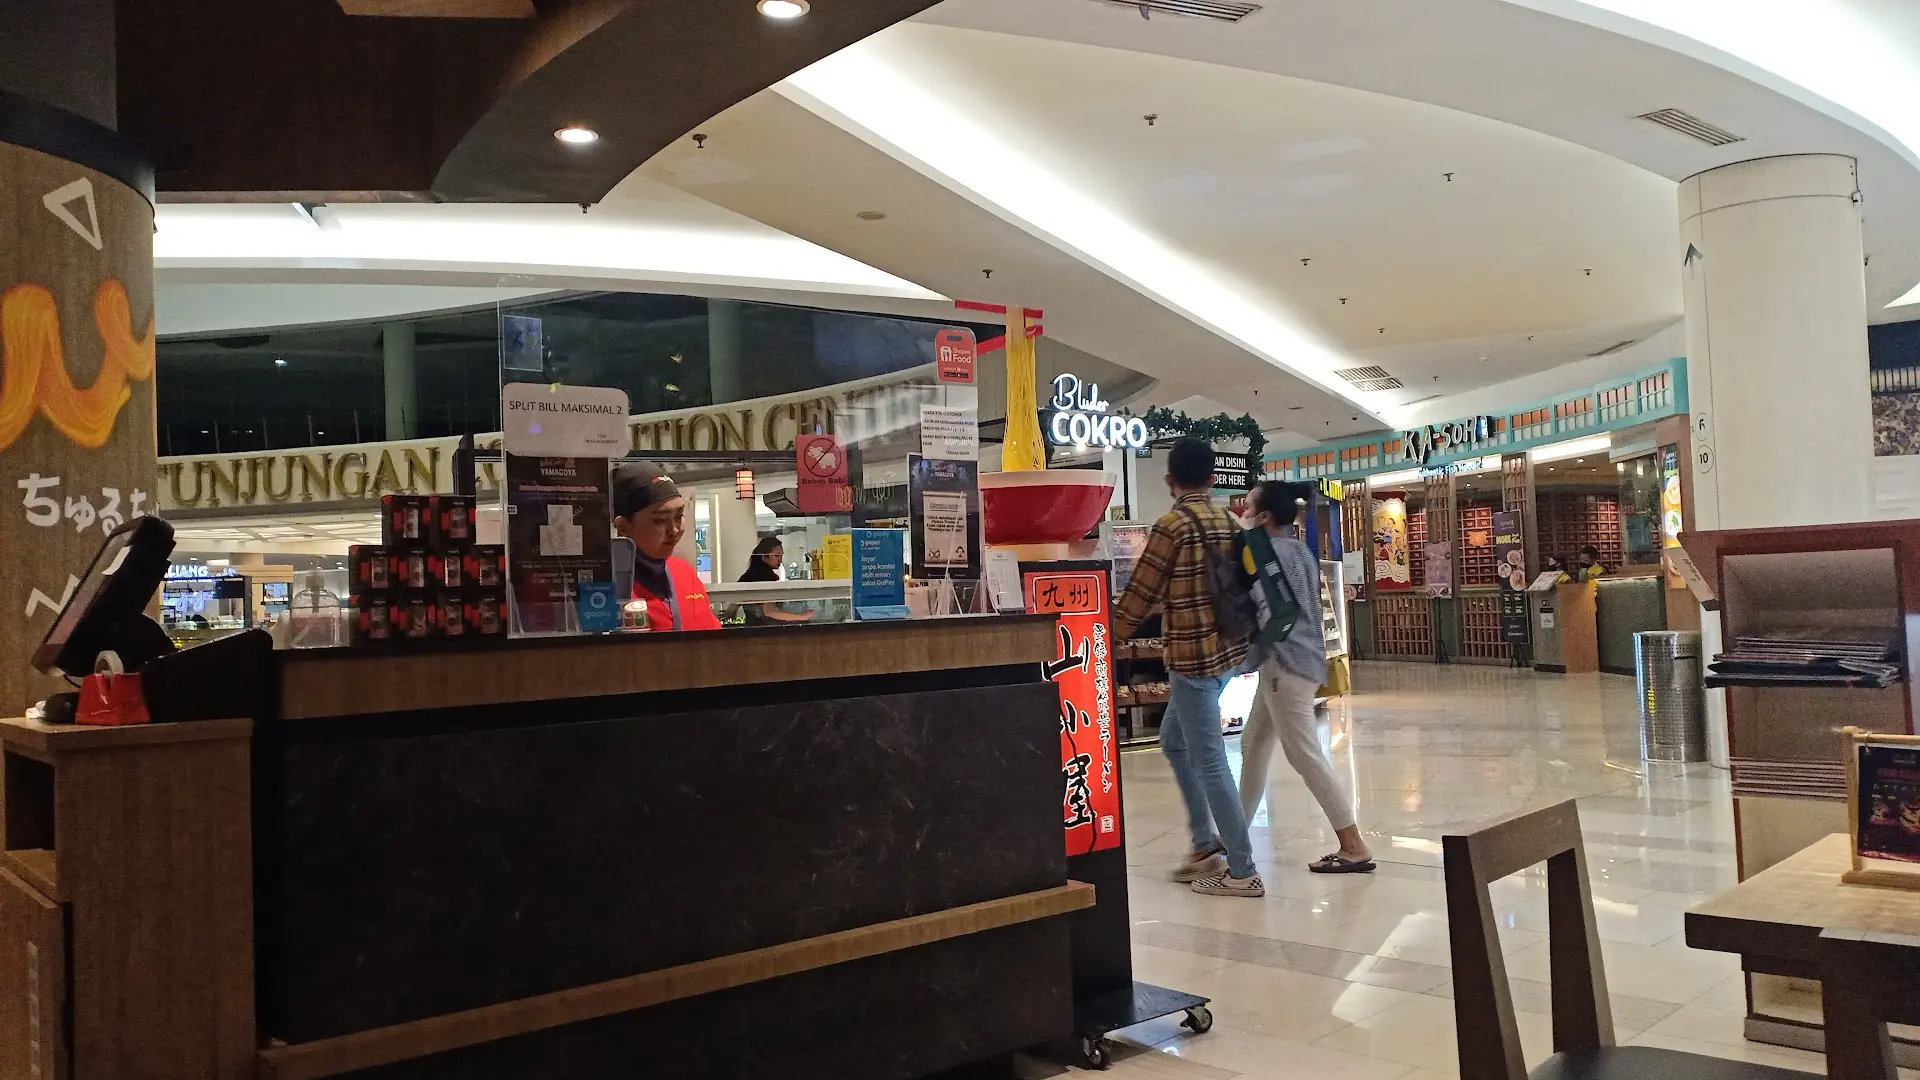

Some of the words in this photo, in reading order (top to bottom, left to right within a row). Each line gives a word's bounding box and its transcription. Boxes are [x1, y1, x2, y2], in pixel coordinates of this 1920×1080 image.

[953, 347, 971, 355] Shopee
[952, 353, 972, 364] Food
[509, 400, 536, 411] SPLIT
[539, 402, 559, 412] BILL
[561, 403, 615, 415] MAKSIMAL
[616, 405, 623, 415] 2
[1052, 411, 1147, 448] COKRO
[1214, 456, 1225, 468] AN
[1226, 457, 1246, 469] DISINI
[1699, 452, 1709, 464] 10
[540, 467, 577, 476] YAMAGOYA
[1445, 464, 1458, 474] Fish
[1213, 474, 1227, 485] DER
[1228, 475, 1246, 486] HERE
[877, 579, 895, 587] GoPay
[1042, 583, 1090, 608] 九州
